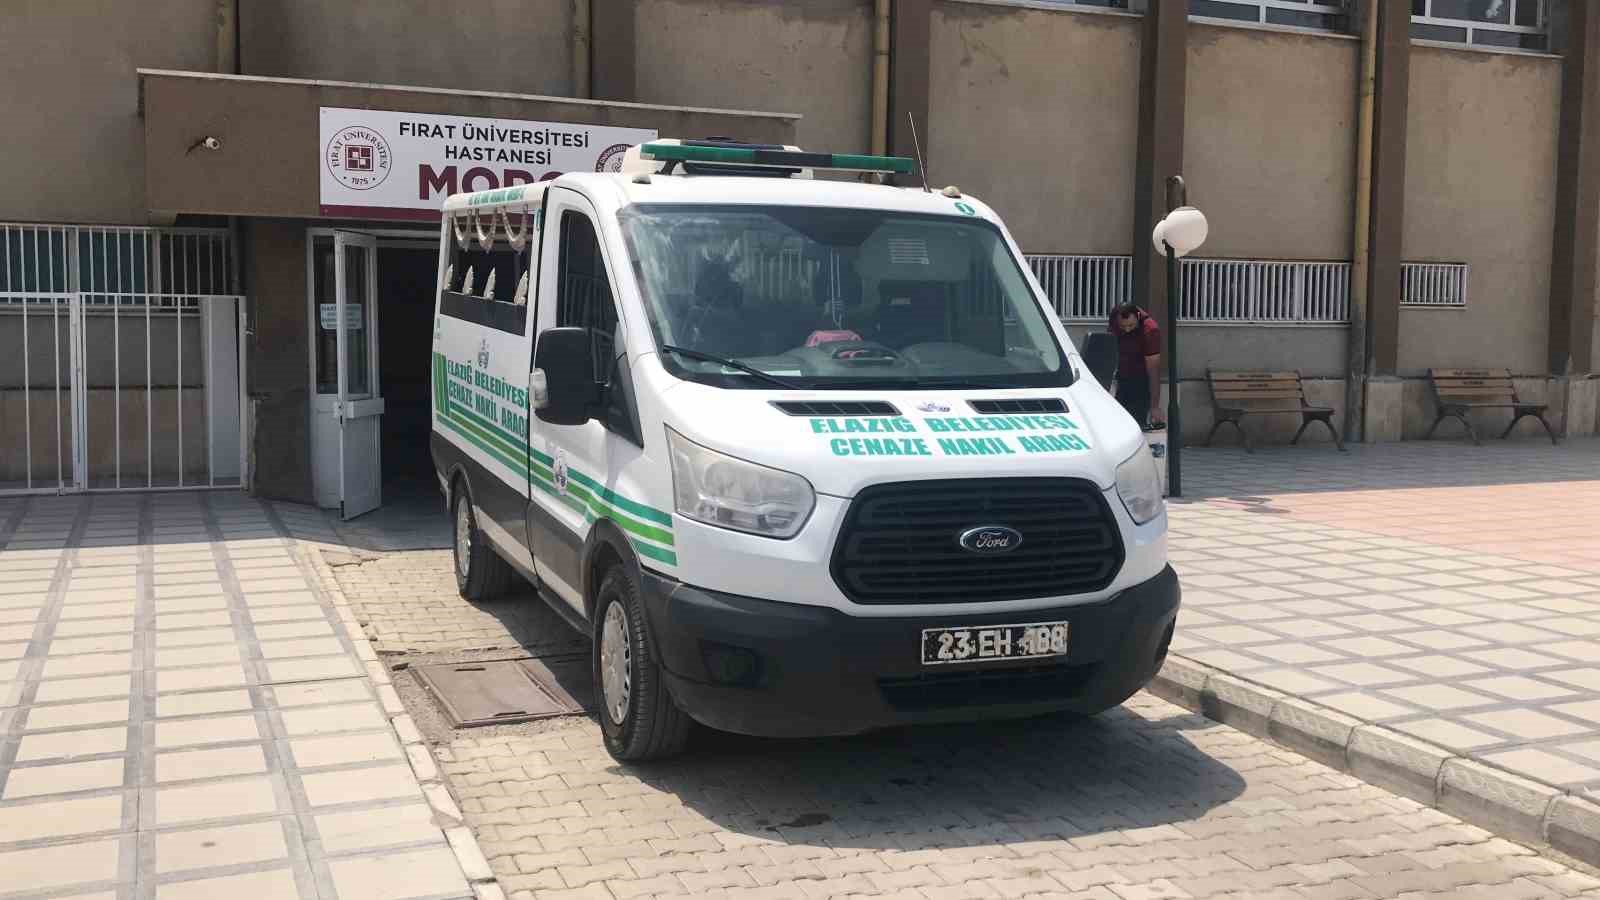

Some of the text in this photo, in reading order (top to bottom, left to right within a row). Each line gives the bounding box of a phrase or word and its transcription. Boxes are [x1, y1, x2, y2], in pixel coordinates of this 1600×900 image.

[399, 122, 589, 148] FIRAT ÜNİVERSİTESİ
[445, 145, 551, 165] HASTANESİ
[418, 164, 566, 201] MO
[448, 380, 473, 408] CENAZE
[830, 437, 932, 456] CENAZE
[1017, 433, 1092, 454] ARACI
[976, 531, 1009, 548] Ford
[938, 631, 971, 659] 23
[978, 629, 1012, 656] EH
